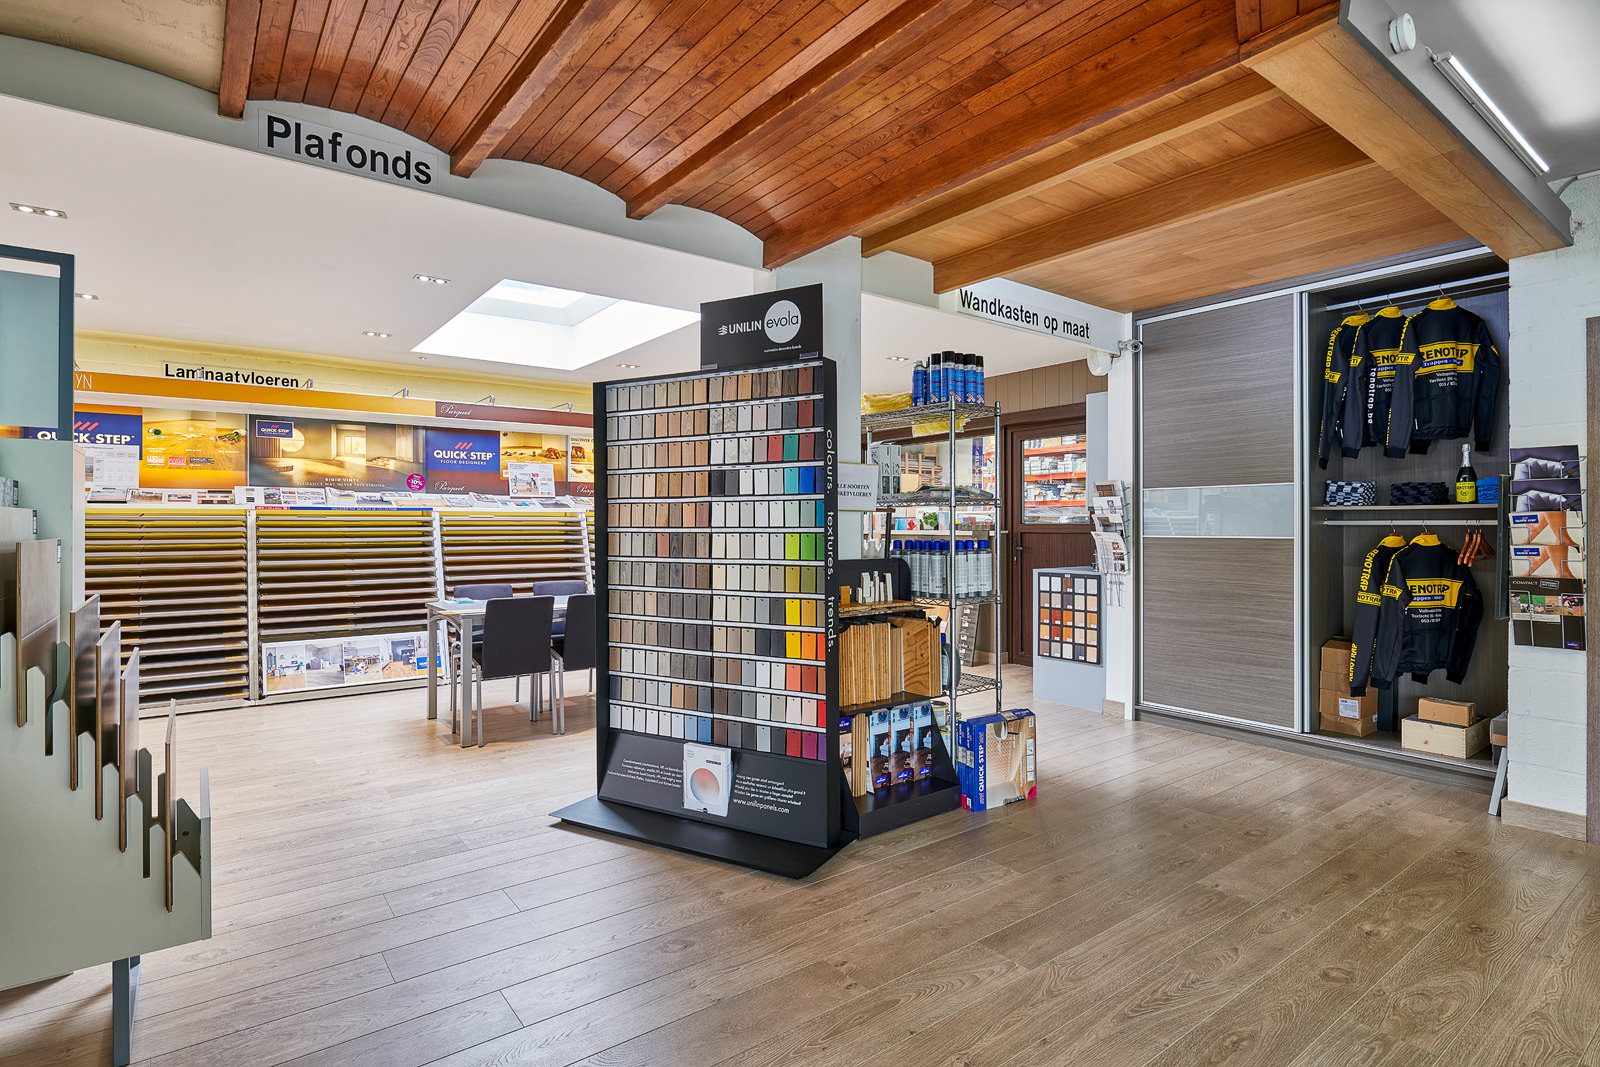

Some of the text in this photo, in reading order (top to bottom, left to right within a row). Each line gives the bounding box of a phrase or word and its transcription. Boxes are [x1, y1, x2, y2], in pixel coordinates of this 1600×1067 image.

[267, 115, 432, 185] Plafonds
[728, 310, 799, 334] UNILIN evola
[959, 288, 1090, 339] Wandkasten op maat
[164, 363, 300, 388] Laminaatvloeren
[1367, 367, 1377, 424] renotrap.be
[440, 404, 472, 417] Parquet
[826, 429, 835, 494] colours.
[827, 511, 836, 580] textures.
[1359, 549, 1380, 591] RENOTRAP
[827, 596, 837, 653] trends.
[733, 799, 789, 813] www.unilinpanels.com
